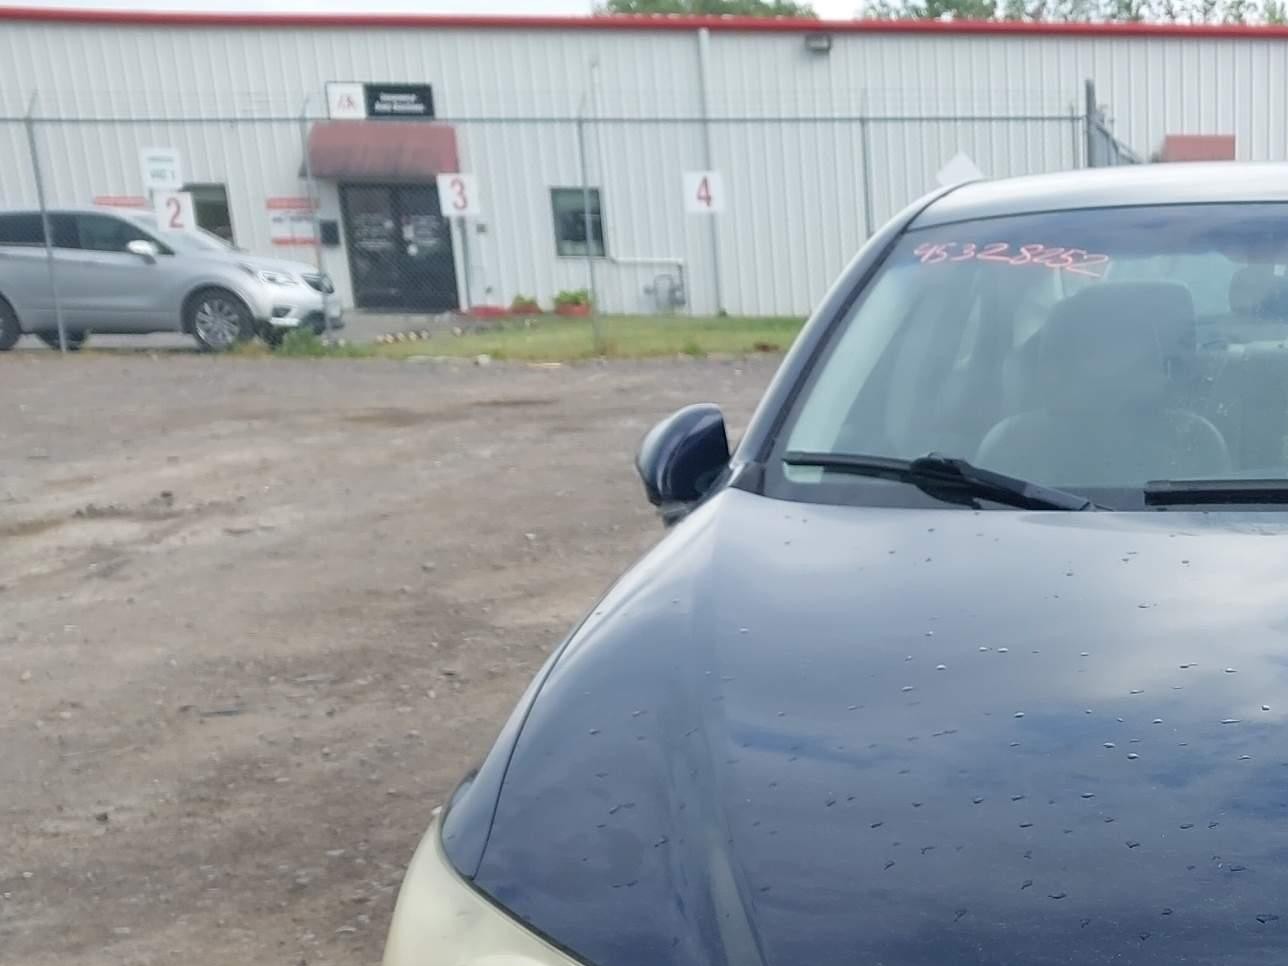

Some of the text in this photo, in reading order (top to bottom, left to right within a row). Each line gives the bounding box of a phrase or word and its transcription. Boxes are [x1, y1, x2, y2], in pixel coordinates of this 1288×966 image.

[449, 177, 466, 210] 3
[696, 177, 713, 207] 4
[166, 197, 184, 228] 2
